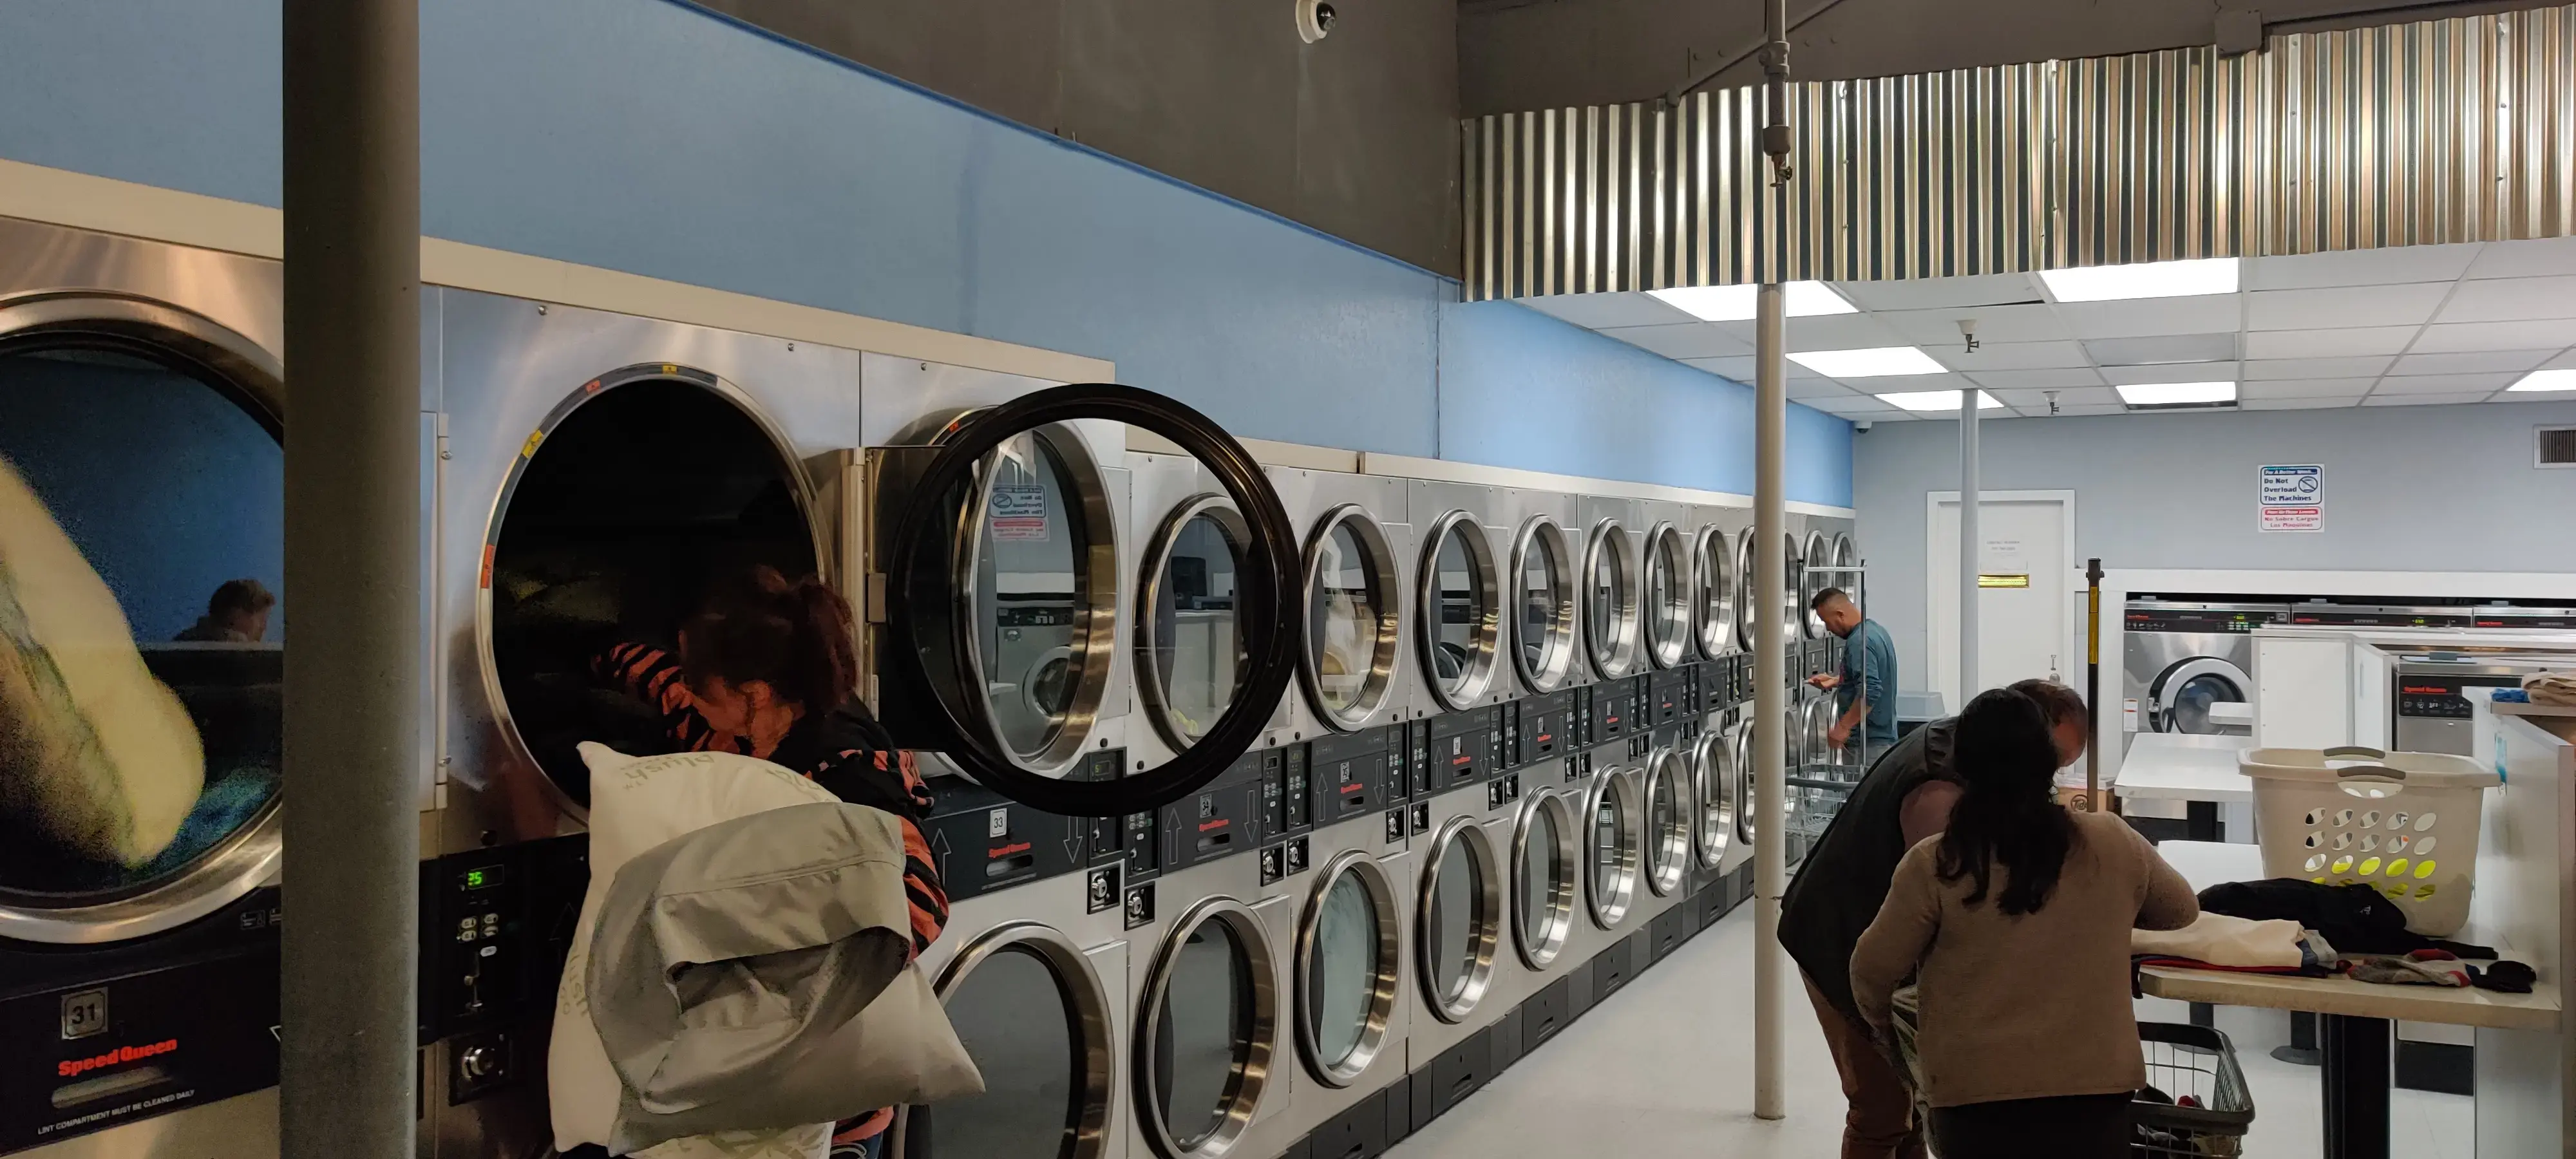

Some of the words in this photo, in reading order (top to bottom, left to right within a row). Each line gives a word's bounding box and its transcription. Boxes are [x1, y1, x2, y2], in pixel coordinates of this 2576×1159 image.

[625, 754, 715, 780] plush
[994, 816, 1003, 829] 33
[71, 1003, 96, 1025] 31
[58, 1050, 119, 1077] Speed
[120, 1039, 178, 1061] Queen
[37, 1124, 55, 1135] LINT
[55, 1110, 111, 1130] COMPARTMENT
[111, 1105, 131, 1116] MUST
[132, 1102, 142, 1111] BE
[143, 1094, 176, 1108] CLEANED
[176, 1089, 195, 1100] DAILY
